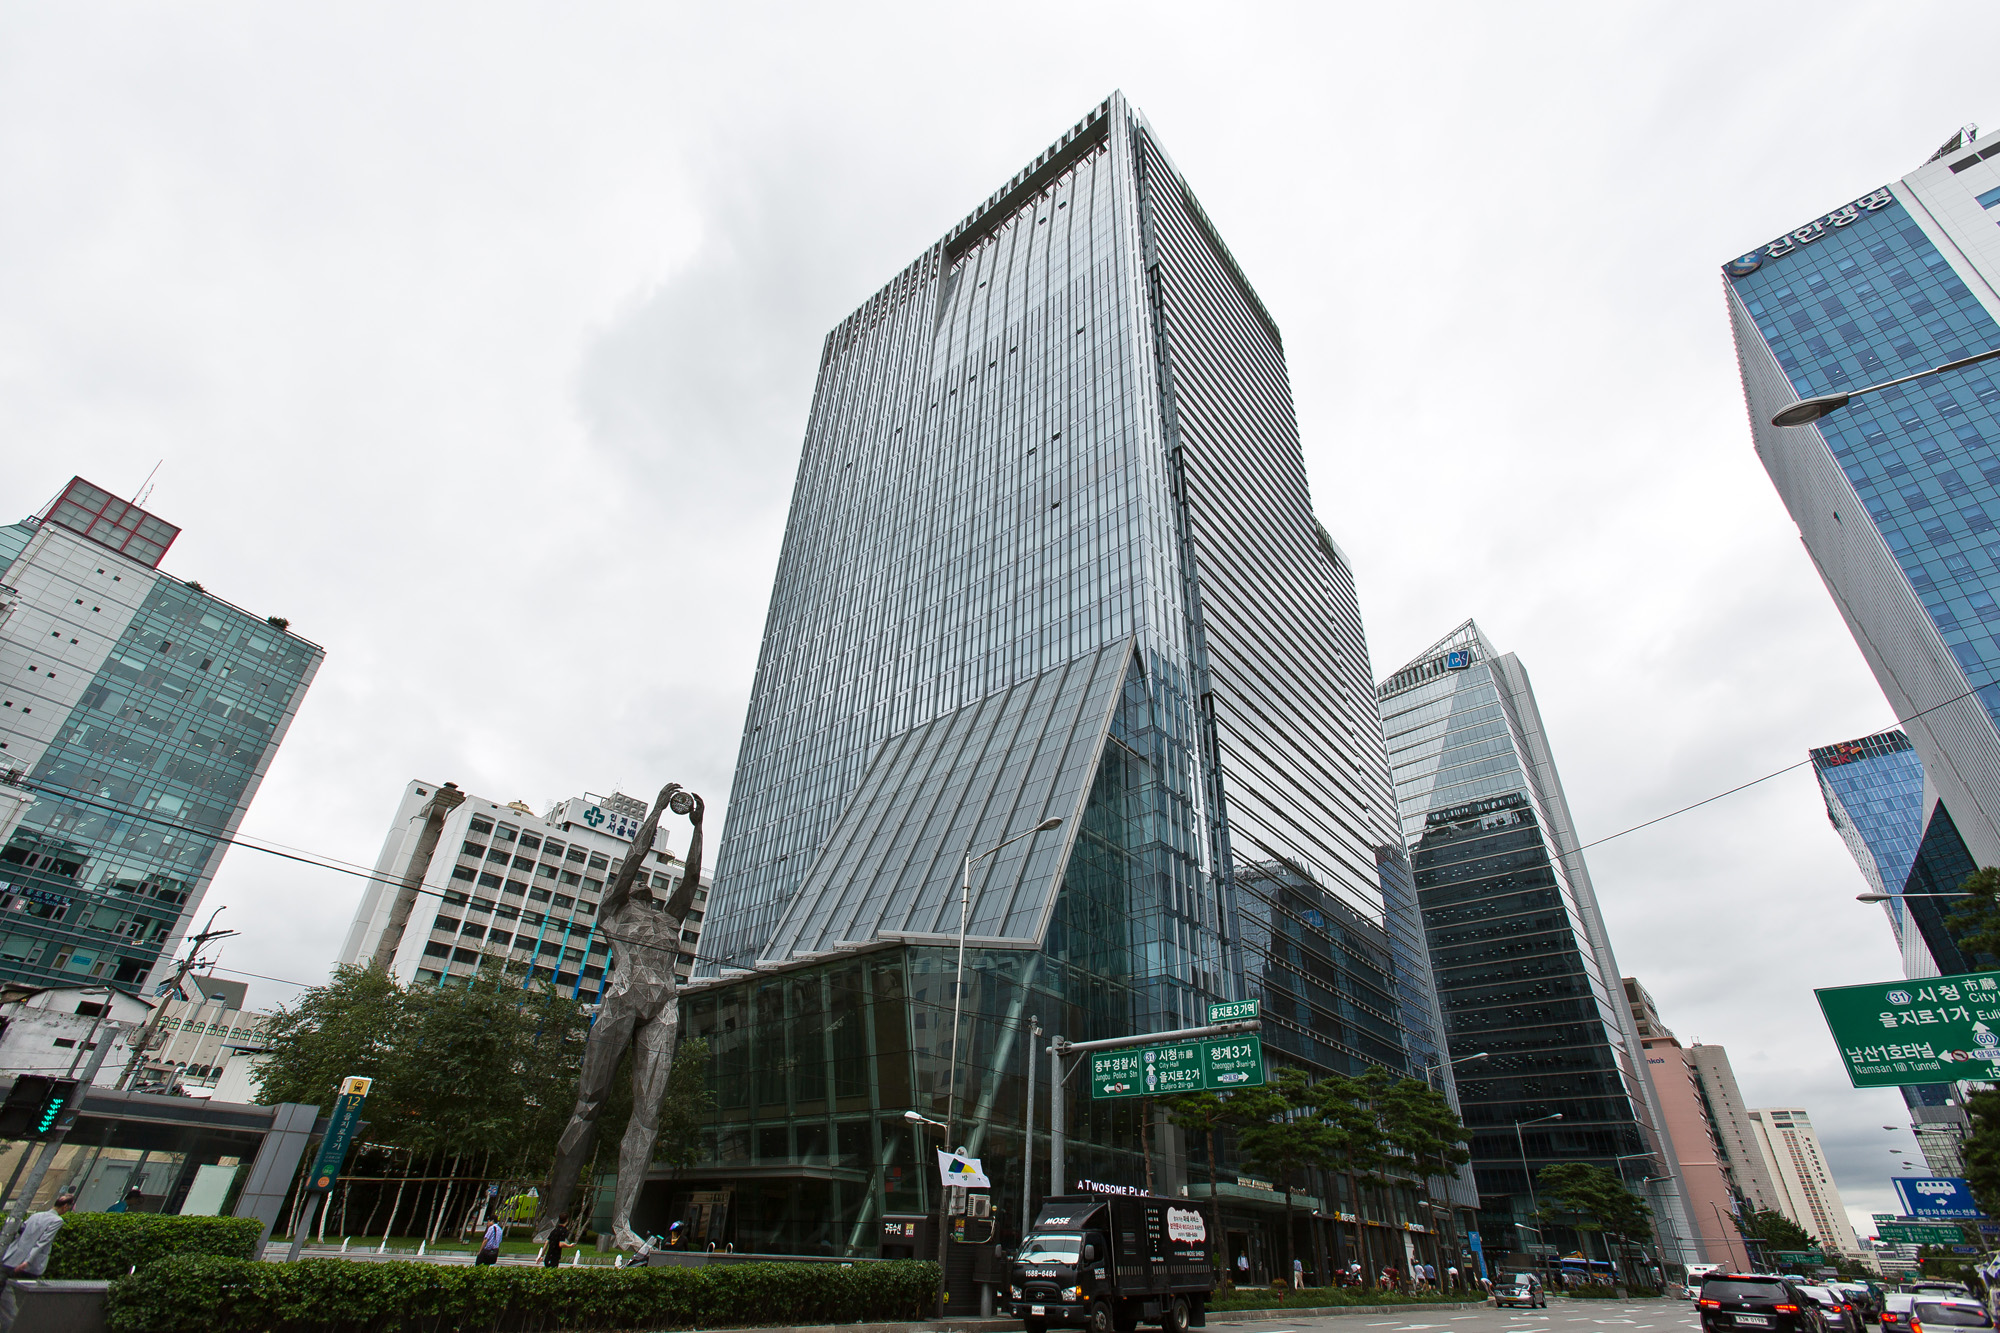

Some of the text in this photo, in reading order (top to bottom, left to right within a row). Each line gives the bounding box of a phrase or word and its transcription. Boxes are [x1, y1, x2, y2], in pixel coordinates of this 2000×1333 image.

[1765, 187, 1892, 258] 신한생명
[1830, 754, 1852, 766] SK
[610, 813, 638, 829] 인제대
[1917, 977, 1998, 1002] 시청 市廳
[1892, 993, 1906, 1002] 31
[1968, 992, 1996, 1004] City
[1211, 1002, 1255, 1020] 을지로3가역
[1879, 1005, 1970, 1028] 을지로1가
[1978, 1034, 1993, 1043] 60
[1146, 1052, 1155, 1061] 31
[1159, 1049, 1177, 1061] 시청
[1211, 1044, 1252, 1060] 청계3가
[1846, 1041, 1936, 1063] 남산1호터널
[1095, 1056, 1138, 1072] 중부경찰서
[1854, 1064, 1892, 1075] Namsan
[1910, 1060, 1941, 1072] Tunnel
[1095, 1070, 1138, 1082] Jungbu Police Stn
[1159, 1069, 1200, 1083] 을지로2가
[347, 1096, 361, 1106] 12
[332, 1112, 352, 1150] 을지로3가
[1077, 1180, 1084, 1190] A
[1129, 1185, 1150, 1197] PLAC
[1044, 1217, 1071, 1225] MOSE
[884, 1223, 902, 1235] 구두수선
